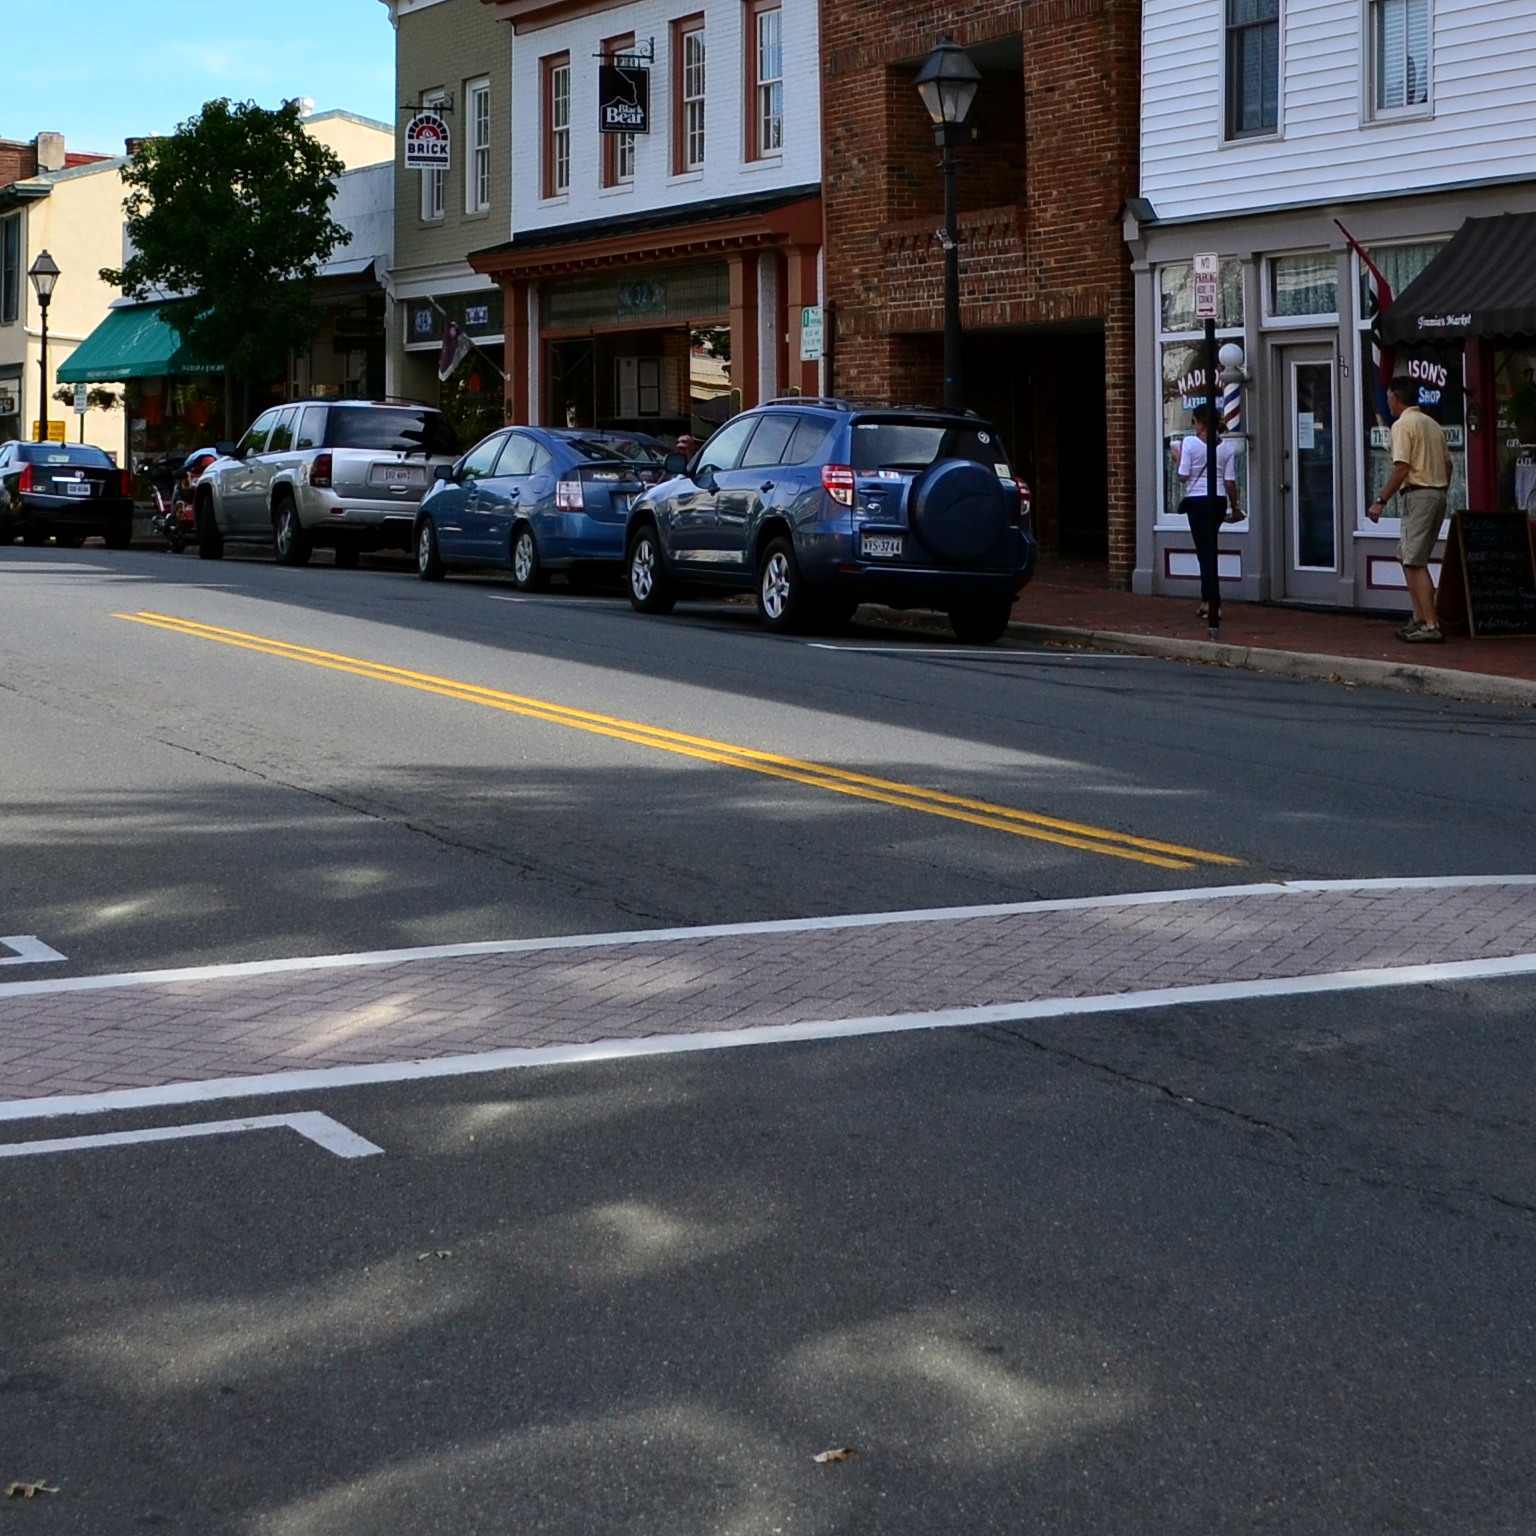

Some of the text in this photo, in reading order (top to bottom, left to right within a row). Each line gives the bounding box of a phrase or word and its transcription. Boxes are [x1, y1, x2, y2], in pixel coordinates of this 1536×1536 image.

[607, 107, 642, 124] Bear
[618, 104, 644, 117] Black
[408, 143, 448, 155] BRICK
[1201, 257, 1211, 269] NO
